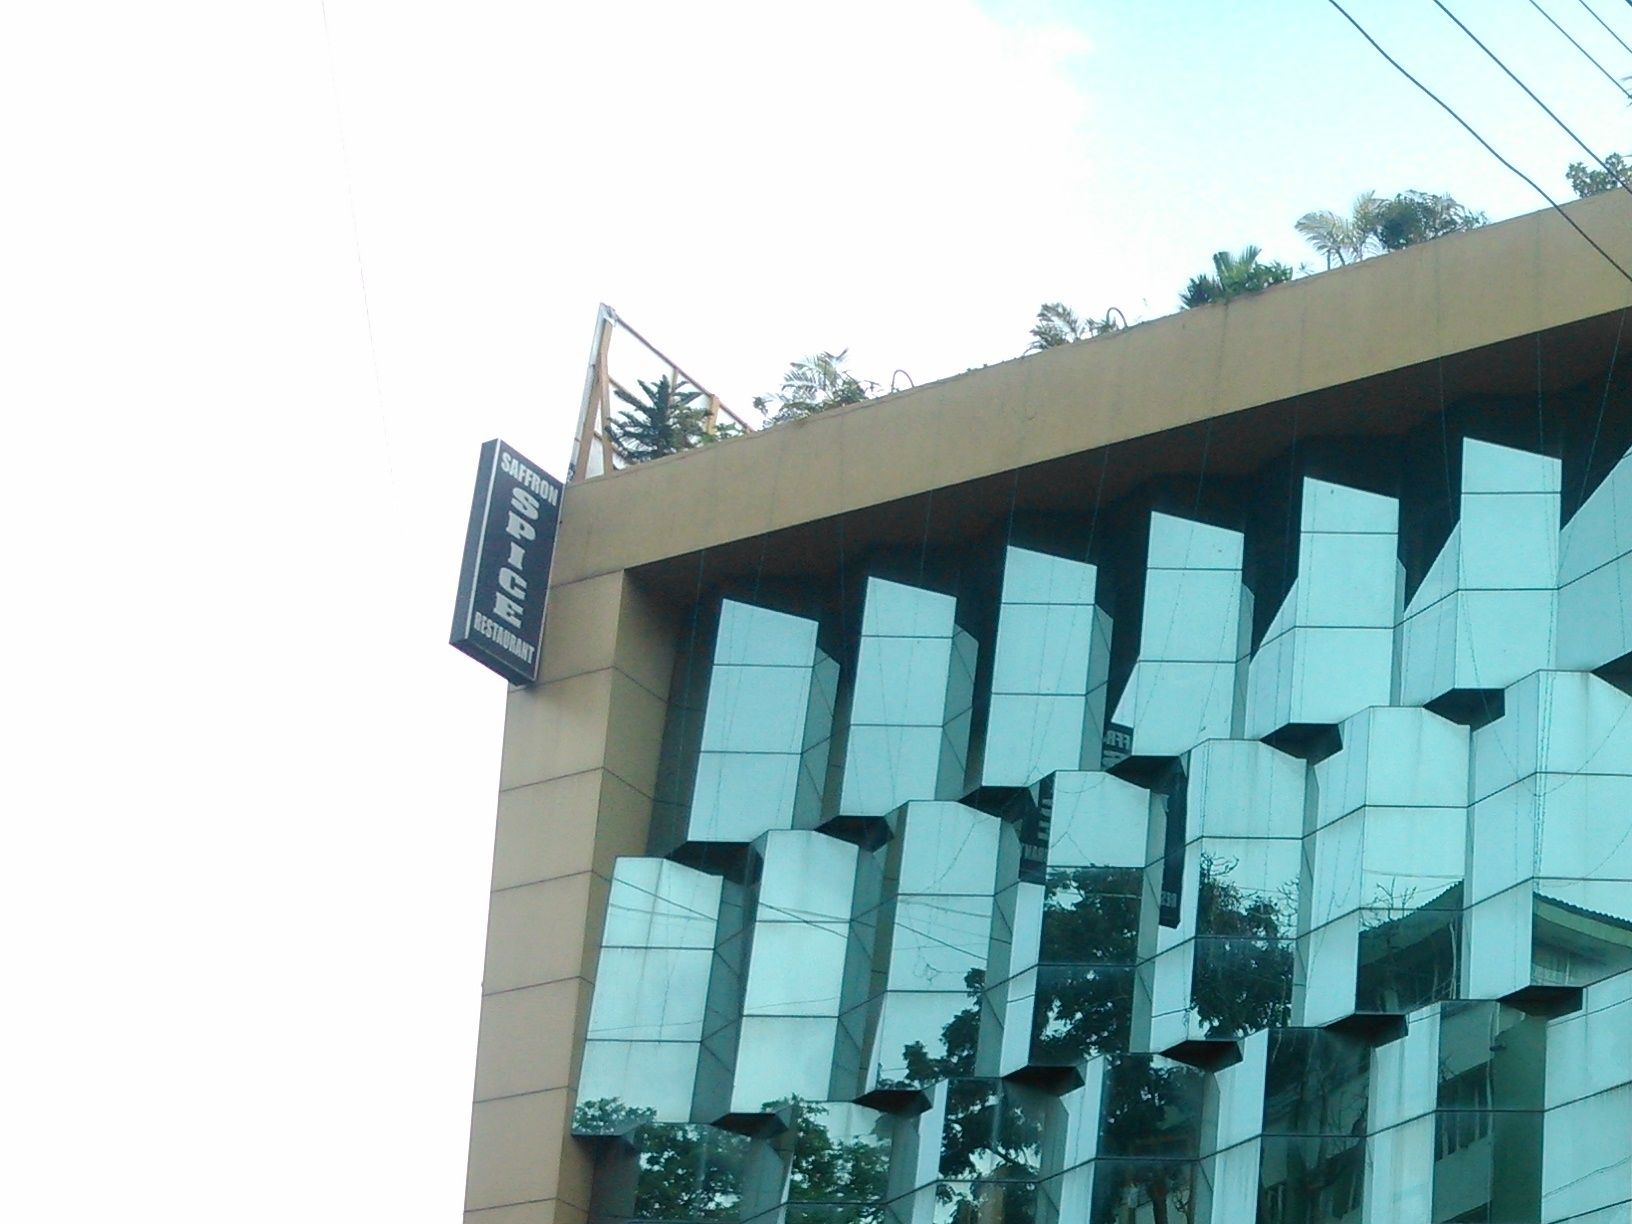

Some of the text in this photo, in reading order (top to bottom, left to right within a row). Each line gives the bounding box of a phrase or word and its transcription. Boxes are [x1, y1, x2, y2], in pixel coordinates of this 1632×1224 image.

[501, 451, 558, 507] SAFFRON
[493, 486, 540, 630] SPICE
[474, 611, 536, 665] RESTAURANT
